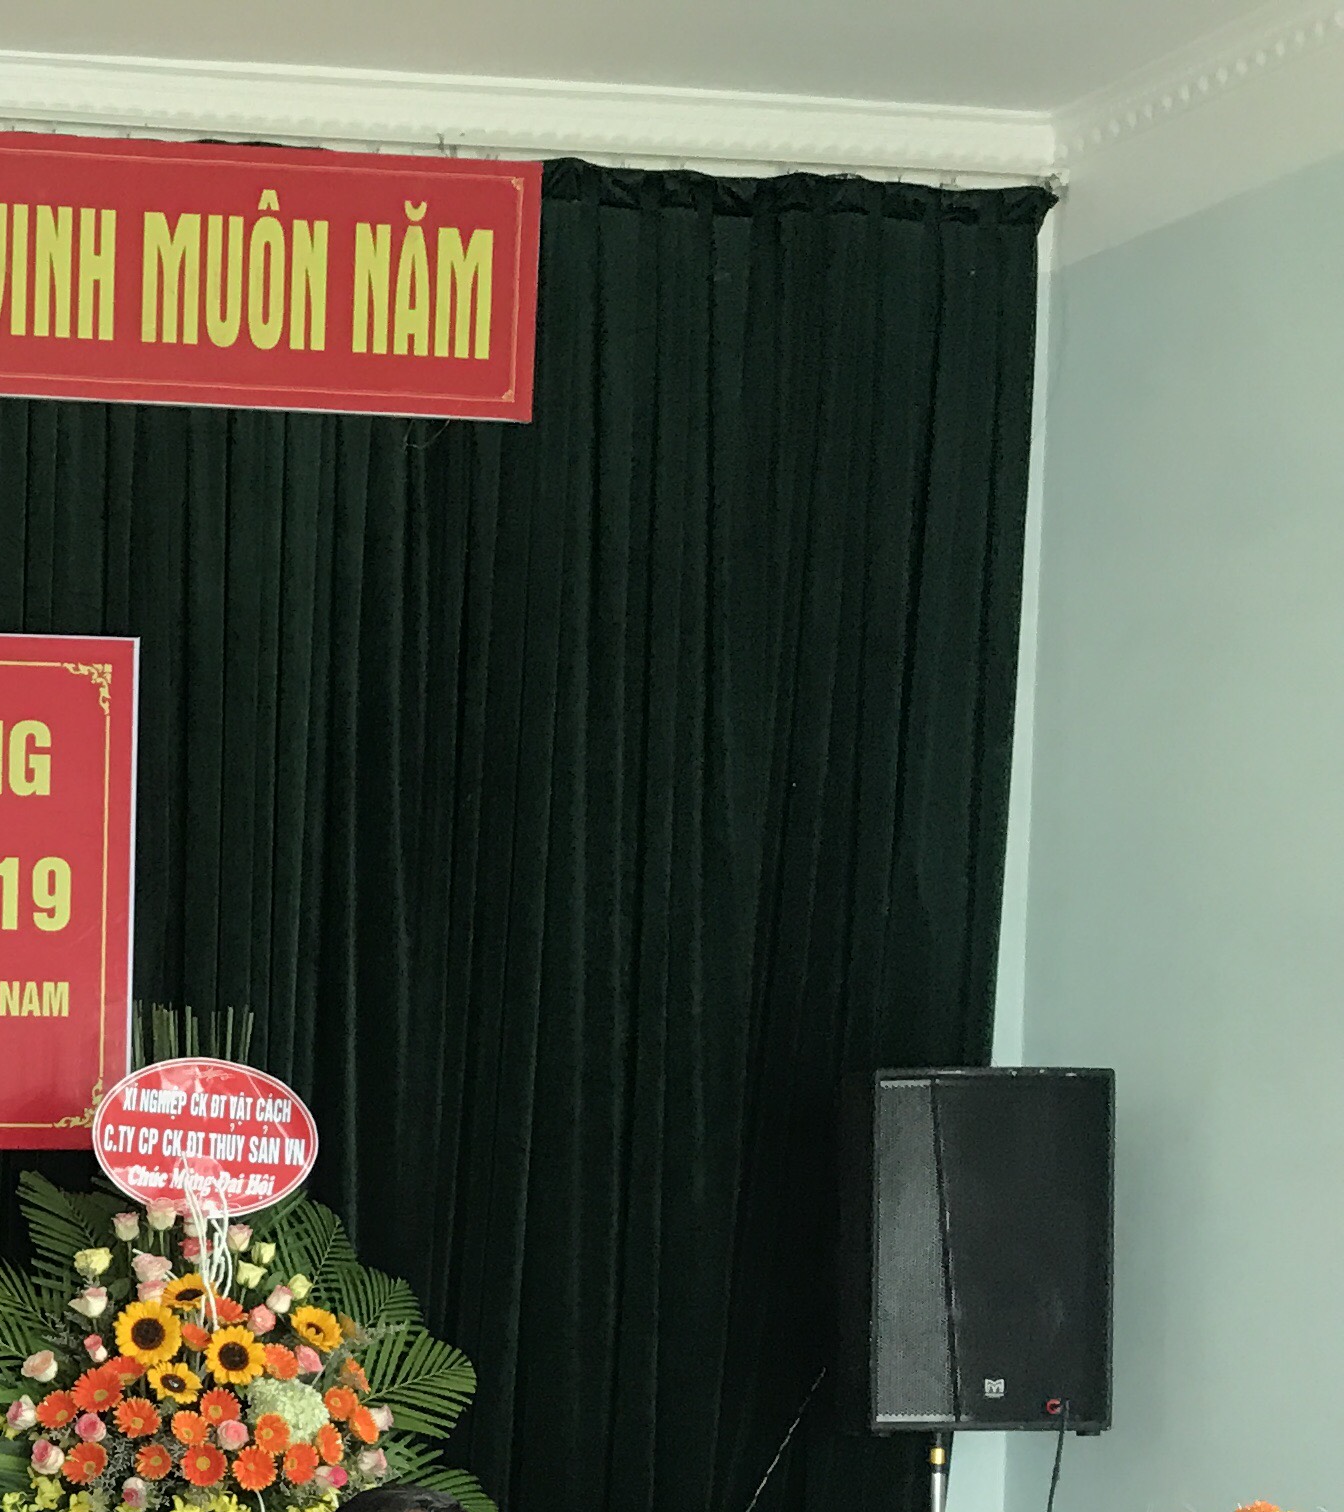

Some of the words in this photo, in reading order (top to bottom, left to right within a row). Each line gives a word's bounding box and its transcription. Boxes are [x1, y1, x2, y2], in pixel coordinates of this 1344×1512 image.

[141, 189, 330, 351] MUÔN
[352, 202, 494, 360] NĂM
[0, 981, 69, 1018] NAM
[139, 1086, 187, 1119] NGHIỆP
[190, 1093, 207, 1116] CK
[210, 1094, 227, 1119] ĐT
[229, 1092, 253, 1125] VẬT
[256, 1093, 292, 1123] CÁCH
[103, 1124, 135, 1153] C.TY
[138, 1128, 159, 1155] CP
[209, 1123, 246, 1162] THỦY
[248, 1125, 280, 1164] SẢN
[284, 1138, 305, 1166] VN
[127, 1165, 168, 1188] Chúc
[245, 1173, 275, 1200] Hội
